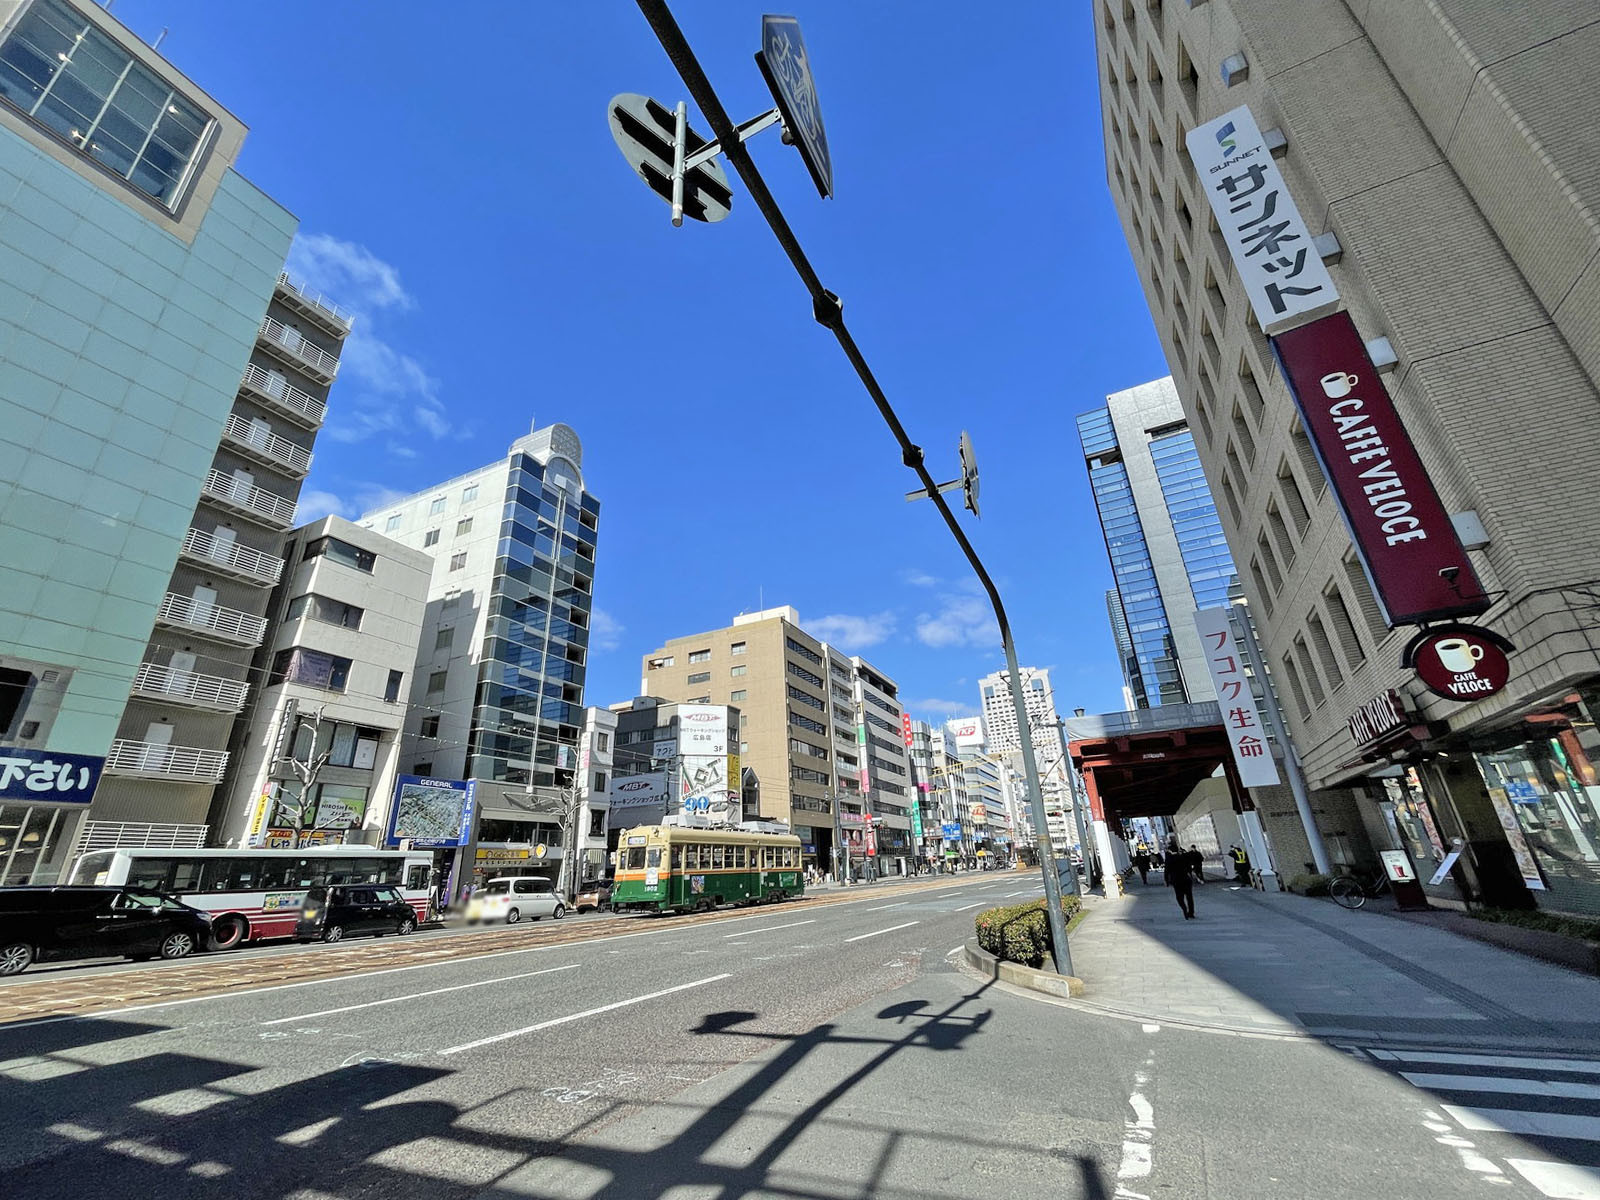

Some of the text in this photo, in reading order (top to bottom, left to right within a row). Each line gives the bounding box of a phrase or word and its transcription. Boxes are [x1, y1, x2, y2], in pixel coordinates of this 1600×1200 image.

[1210, 145, 1262, 174] SUNNET
[1216, 163, 1323, 315] サンネット
[1358, 459, 1427, 547] VELOCE
[1205, 631, 1263, 758] フコク生命
[1447, 678, 1493, 695] VELOCE
[1363, 689, 1400, 733] VELOCE
[420, 779, 453, 789] GENERAL
[622, 782, 646, 791] MBT
